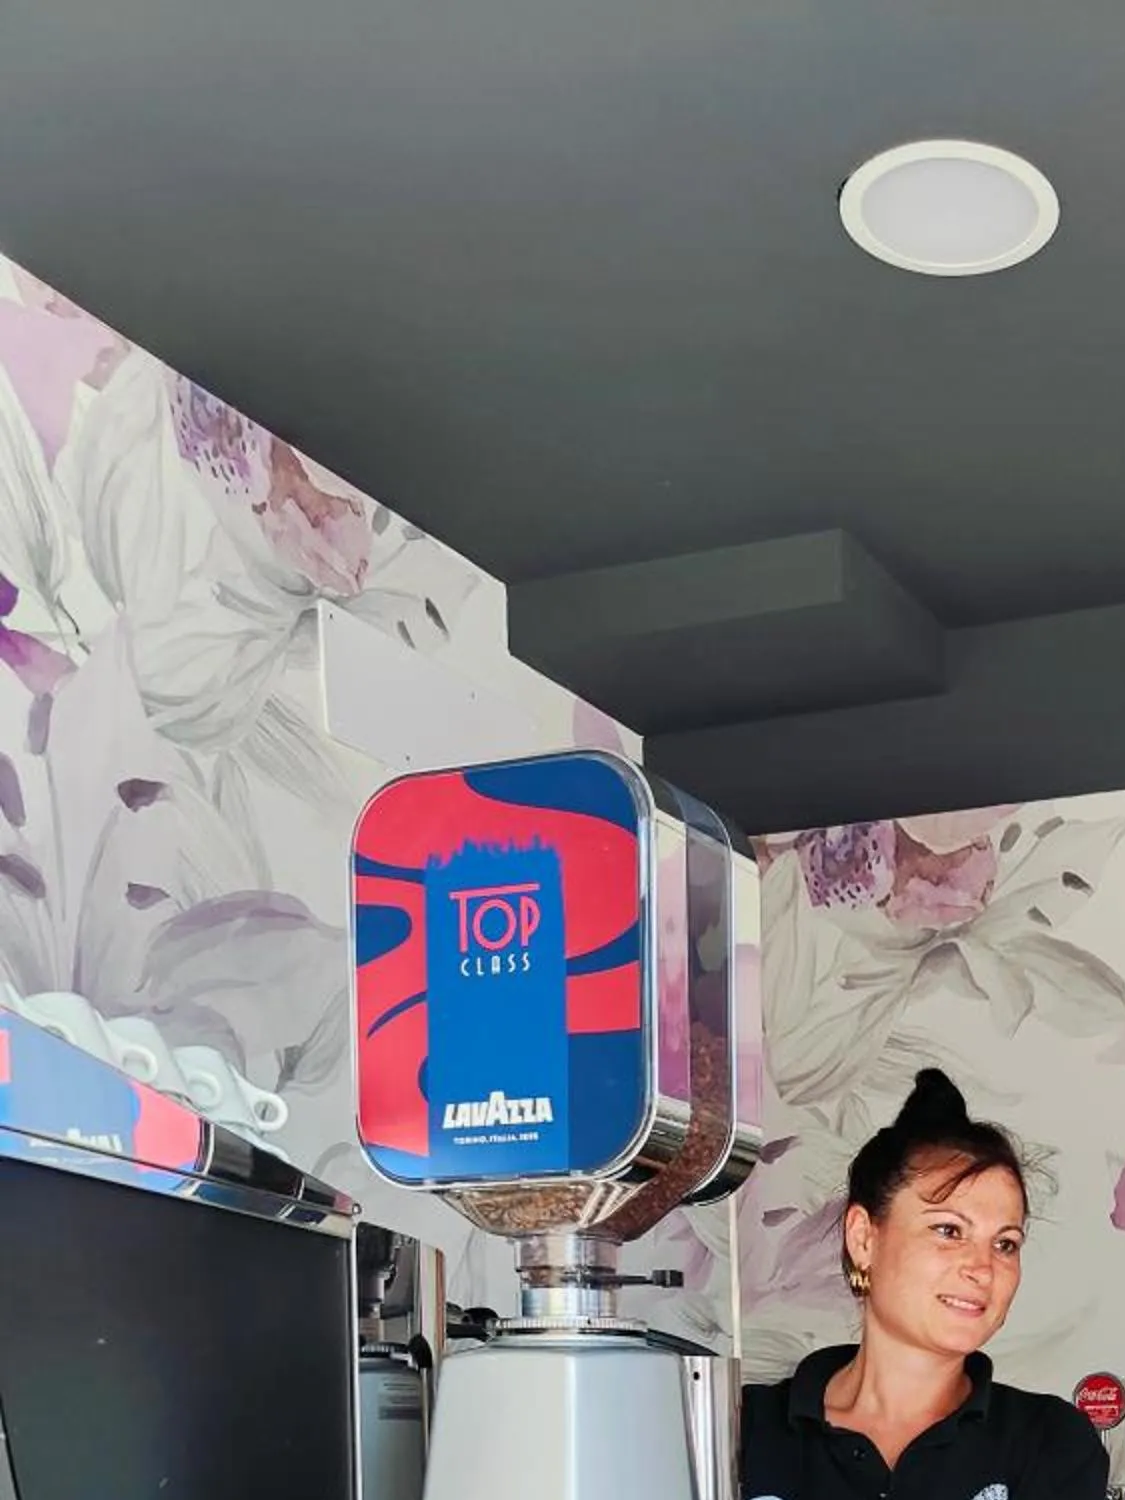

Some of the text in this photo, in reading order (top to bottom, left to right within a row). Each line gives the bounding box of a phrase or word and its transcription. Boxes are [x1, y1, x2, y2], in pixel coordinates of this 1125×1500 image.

[448, 883, 540, 953] TOP
[460, 952, 531, 977] CLASS
[442, 1090, 554, 1129] LAVAZZA
